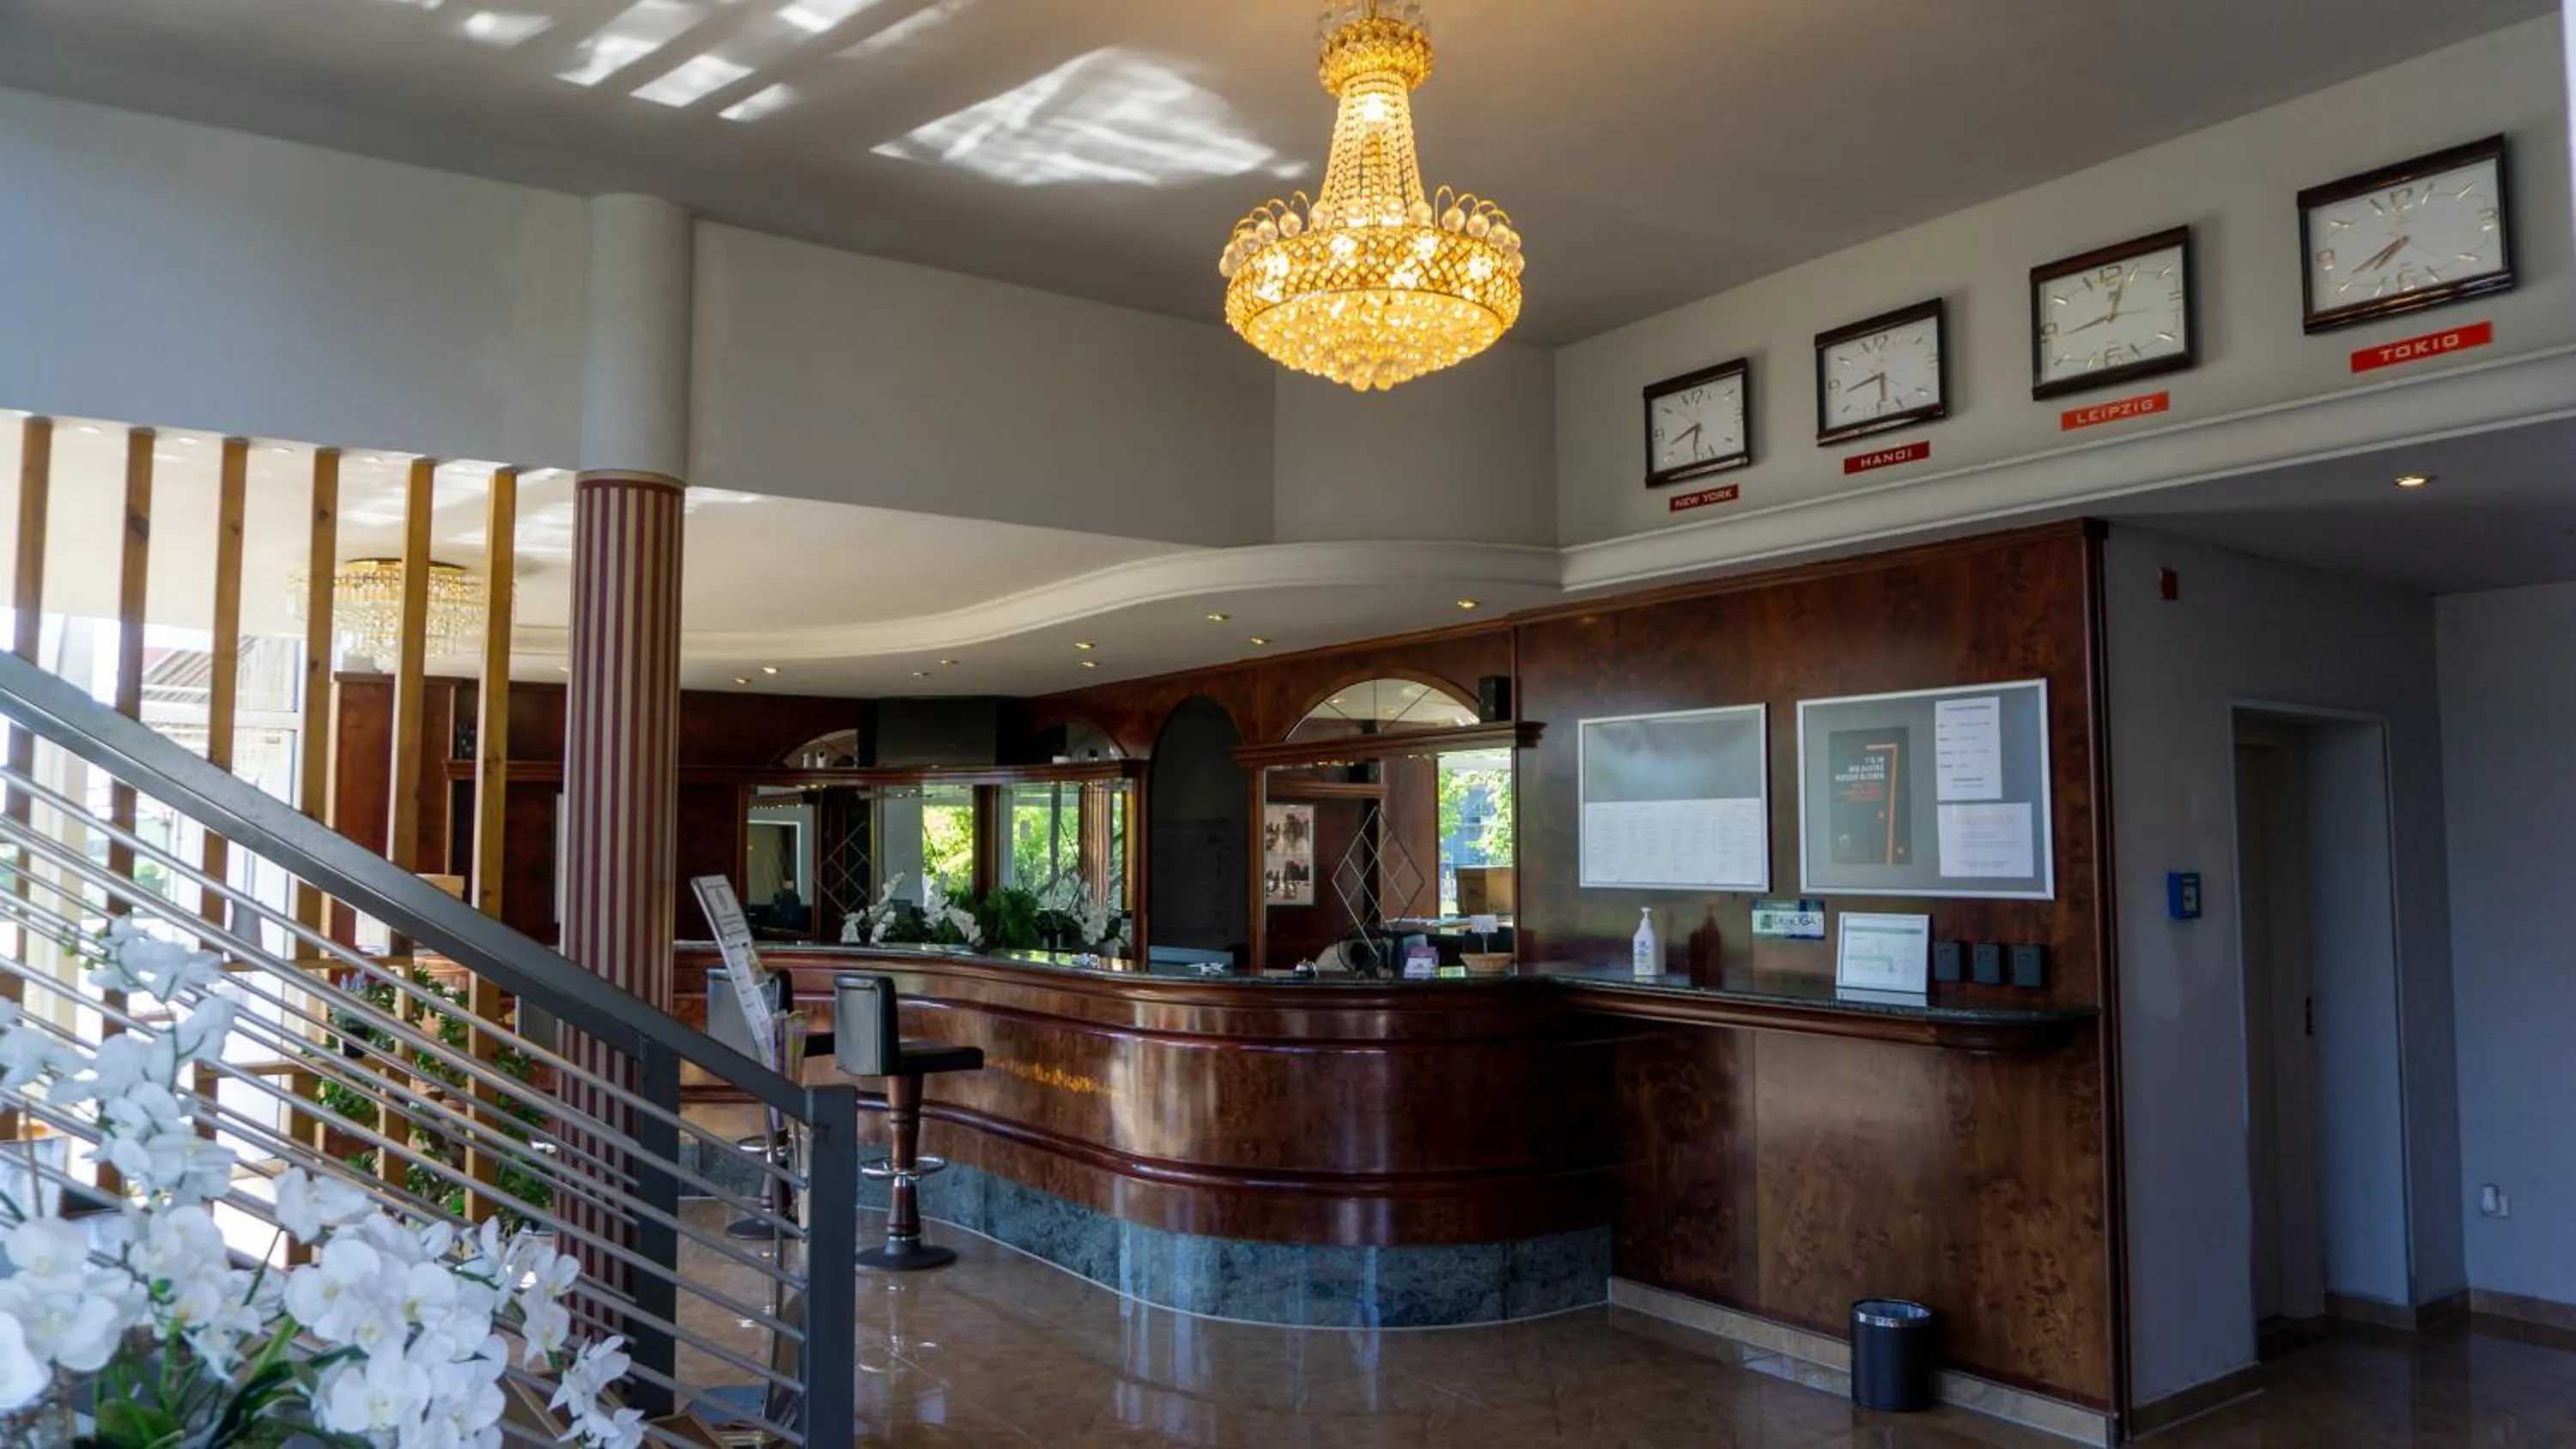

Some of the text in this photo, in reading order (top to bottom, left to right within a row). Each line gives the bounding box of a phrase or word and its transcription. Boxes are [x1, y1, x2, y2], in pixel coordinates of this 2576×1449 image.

[2379, 333, 2460, 361] TOKIO
[2075, 397, 2155, 424] LEIPZIG
[1860, 448, 1913, 468] HANOI
[1675, 488, 1733, 508] NEW YORK
